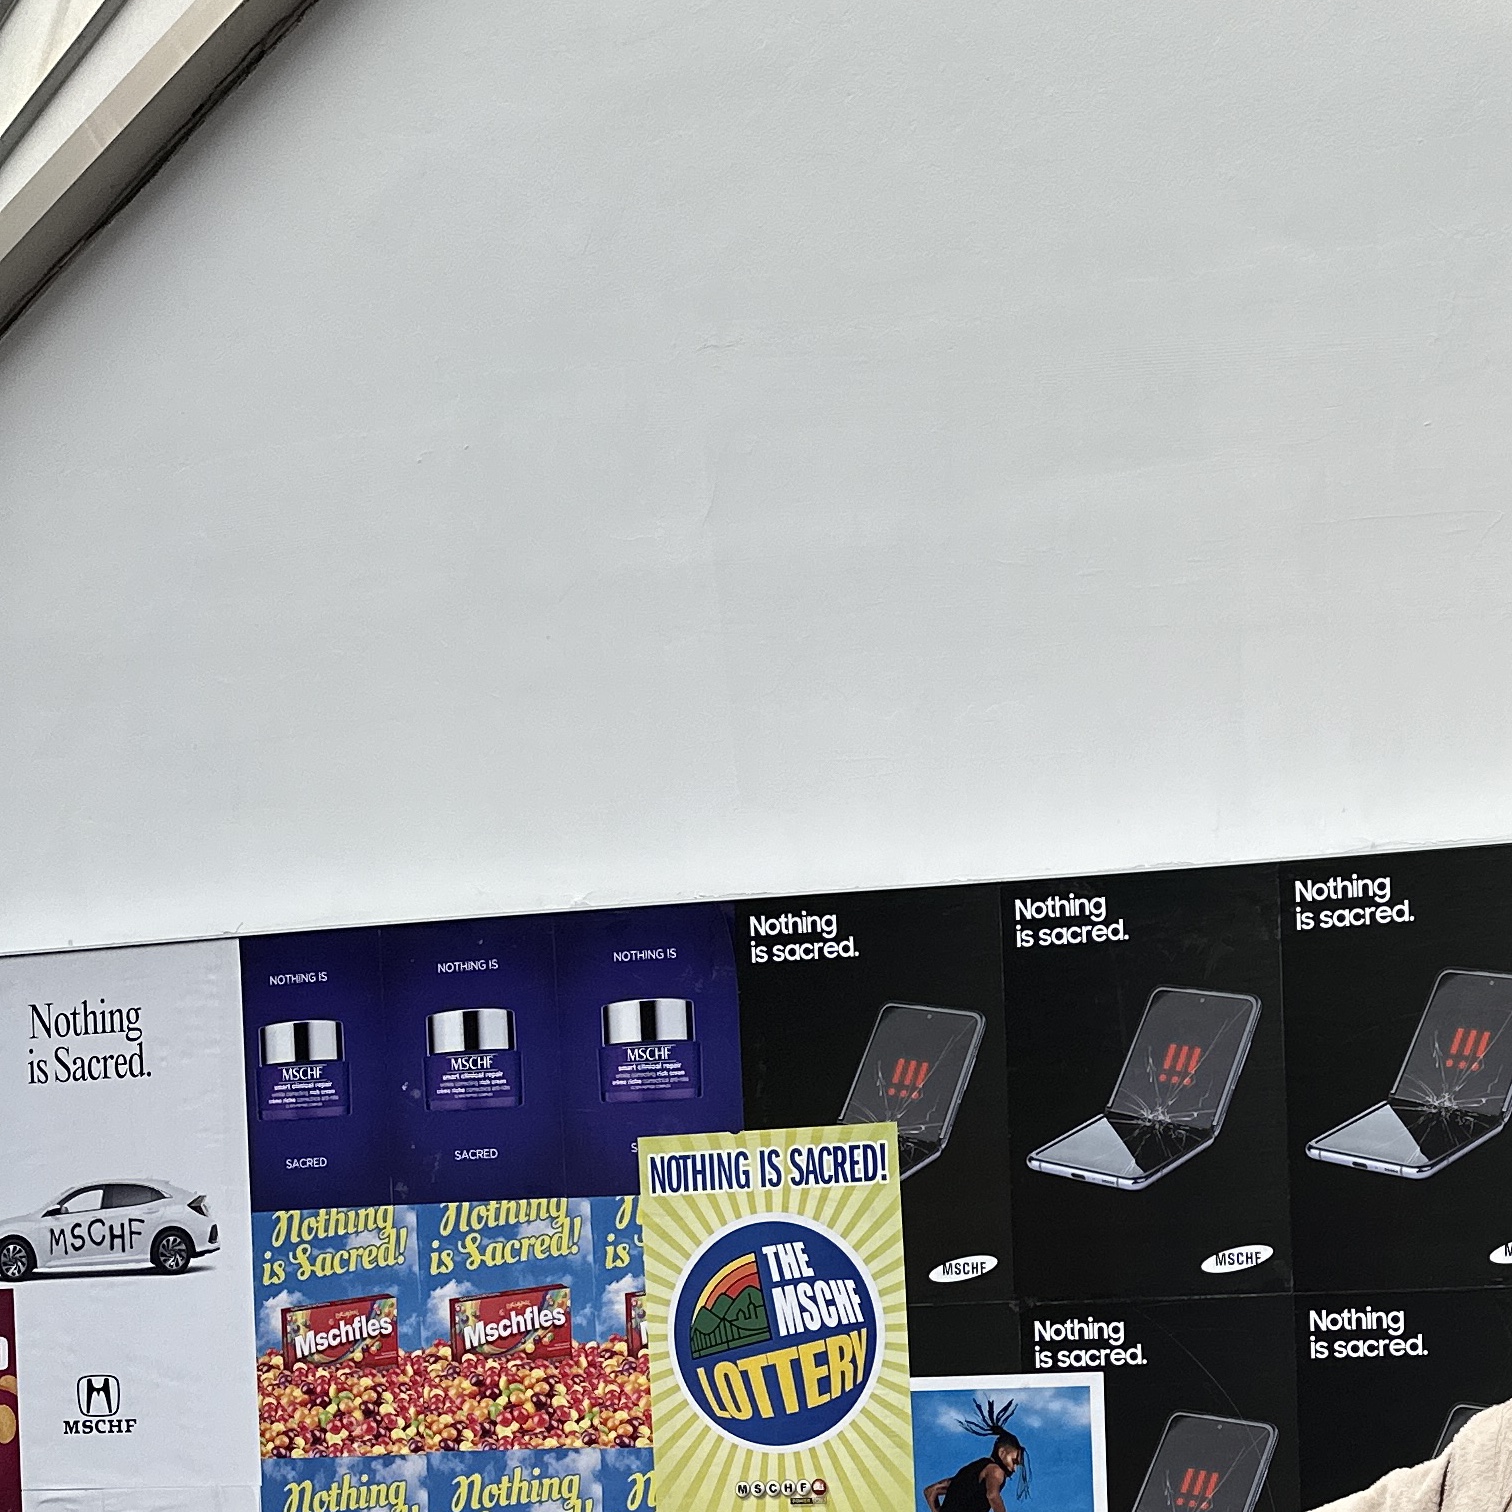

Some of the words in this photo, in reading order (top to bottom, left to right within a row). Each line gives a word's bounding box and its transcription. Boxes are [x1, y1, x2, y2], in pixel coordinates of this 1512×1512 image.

[1294, 873, 1391, 903] Nothing
[1014, 893, 1107, 922] Nothing
[1295, 907, 1315, 931] is
[1319, 899, 1415, 928] sacred.
[749, 911, 838, 939] Nothing
[1016, 924, 1034, 948] is
[1038, 919, 1130, 945] sacred.
[613, 949, 664, 962] NOTHING
[666, 948, 677, 959] IS
[750, 941, 768, 963] is
[772, 936, 860, 962] sacred.
[269, 973, 316, 986] NOTHING
[318, 972, 328, 983] IS
[437, 960, 486, 973] NOTHING
[488, 959, 499, 970] IS
[28, 998, 142, 1042] Nothing
[28, 1048, 49, 1084] is
[54, 1041, 152, 1083] Sacred.
[451, 1055, 494, 1071] MSCHF
[627, 1046, 672, 1061] MSCHF
[282, 1066, 323, 1081] MSCHF
[285, 1157, 327, 1169] SACRED
[454, 1148, 498, 1160] SACRED
[649, 1150, 751, 1194] NOTHING
[760, 1148, 781, 1188] IS
[789, 1143, 887, 1186] SACRED!
[271, 1204, 394, 1248] Nothing
[440, 1198, 569, 1239] Nothing
[49, 1217, 145, 1255] MSCHF
[430, 1239, 455, 1276] is
[458, 1216, 583, 1271] Sacred!
[262, 1251, 286, 1287] is
[289, 1226, 409, 1282] Sacred!
[762, 1240, 816, 1282] THE
[941, 1261, 987, 1278] MSCHF
[1214, 1251, 1263, 1269] MSCHF
[772, 1278, 865, 1337] MSCHF
[1309, 1306, 1405, 1336] Nothing
[294, 1315, 393, 1359] Mschfles
[463, 1305, 566, 1353] Mschfles
[1033, 1317, 1125, 1345] Nothing
[1034, 1346, 1053, 1369] is
[1057, 1344, 1148, 1367] sacred.
[1310, 1336, 1328, 1359] is
[1333, 1334, 1429, 1358] sacred.
[696, 1327, 868, 1421] LOTTERY
[63, 1418, 137, 1435] MSCHF
